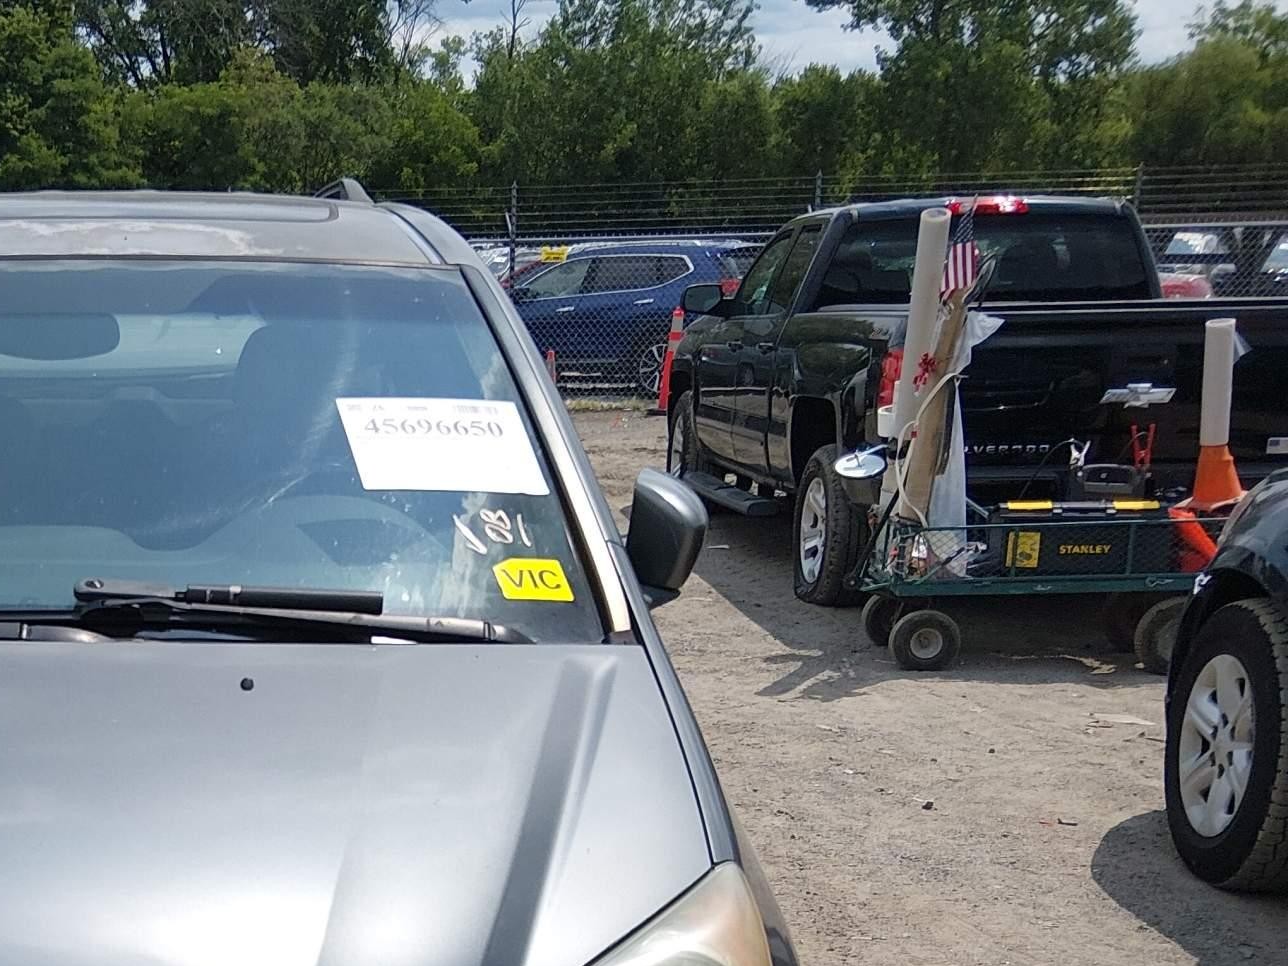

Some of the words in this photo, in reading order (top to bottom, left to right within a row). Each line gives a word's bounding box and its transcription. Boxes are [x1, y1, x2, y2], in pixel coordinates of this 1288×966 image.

[364, 418, 504, 438] 45696650
[1058, 544, 1112, 554] STANLEY
[500, 568, 562, 590] VIC
